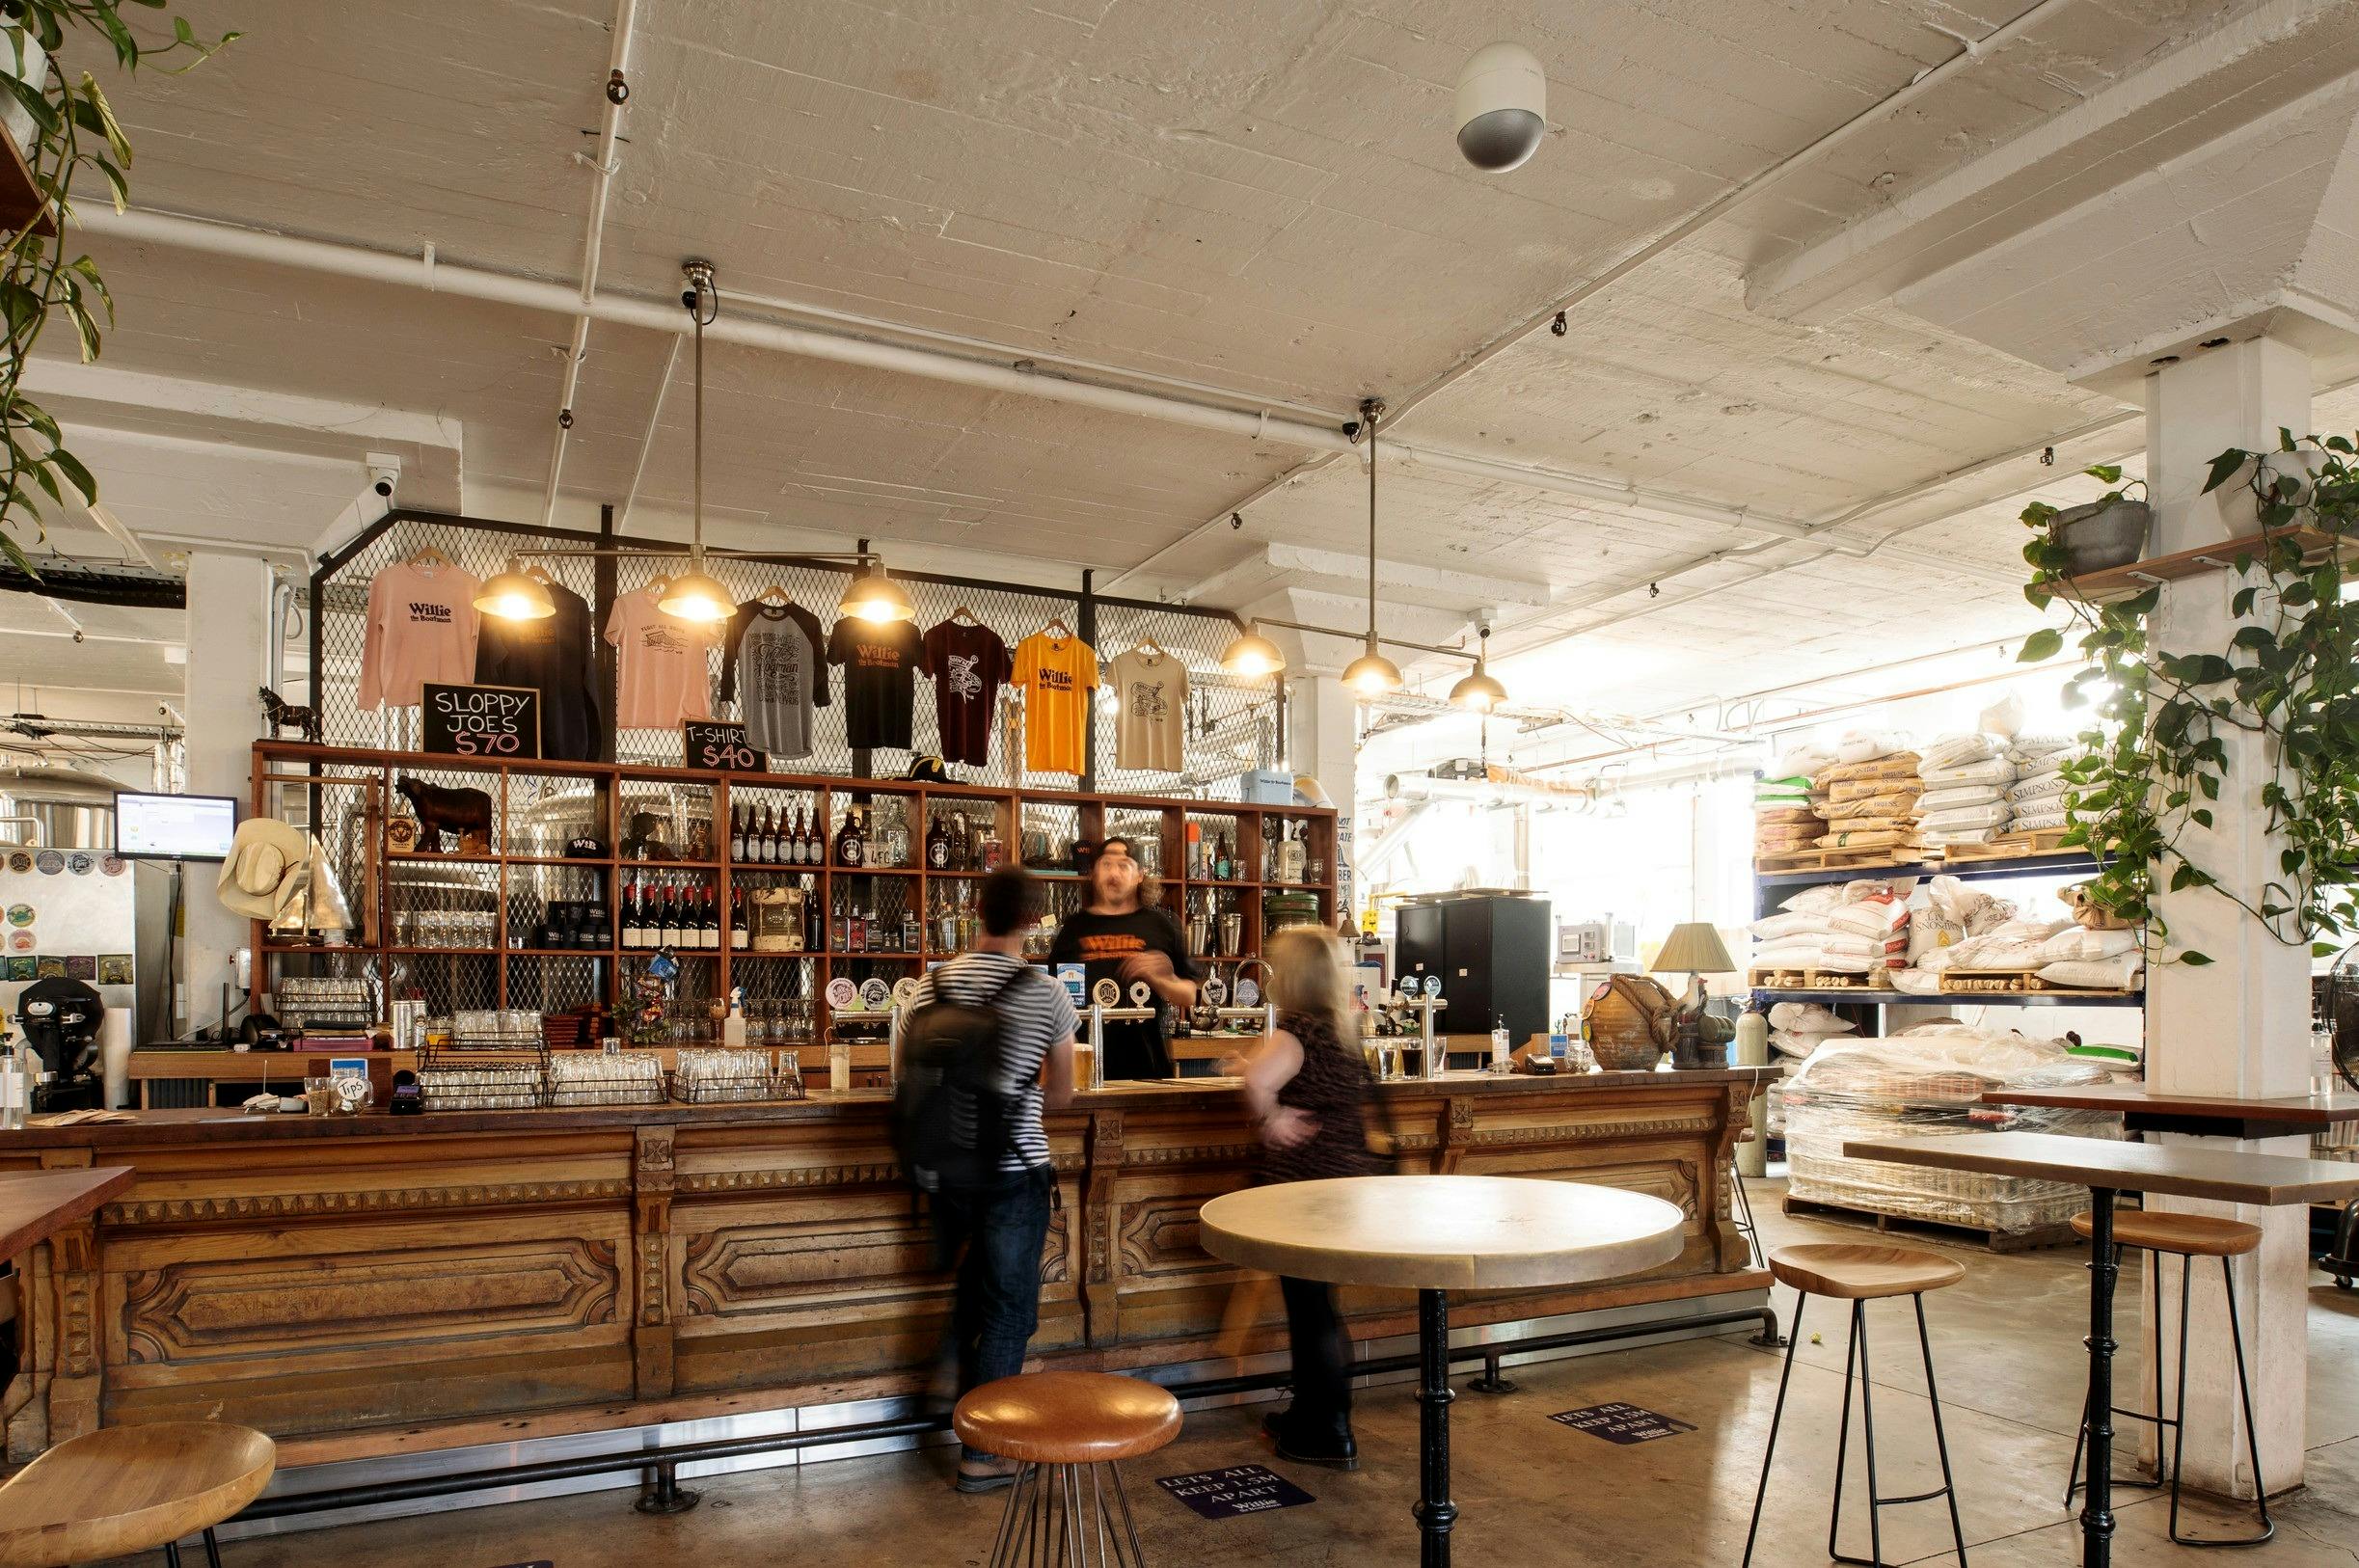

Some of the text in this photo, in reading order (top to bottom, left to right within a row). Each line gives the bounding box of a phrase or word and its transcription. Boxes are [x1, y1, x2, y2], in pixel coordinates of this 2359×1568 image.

[409, 603, 451, 616] Willie
[856, 644, 901, 660] Willie
[1039, 668, 1072, 684] Willie
[435, 692, 530, 716] SLOPPY
[447, 715, 518, 733] JOES
[455, 731, 520, 755] $70
[687, 726, 747, 744] T-SHIRT
[702, 744, 755, 769] $40
[2014, 779, 2066, 802] SIMPSONS
[2021, 800, 2061, 816] SIMPSO
[2021, 817, 2067, 831] SIMPSON
[339, 1081, 363, 1098] Tips
[1553, 1404, 1631, 1422] LETS ALL
[1572, 1417, 1613, 1429] KEEP
[1607, 1418, 1661, 1434] APART
[1161, 1467, 1262, 1487] LETS ALL
[1174, 1474, 1281, 1496] KEEP 1.5M
[1210, 1485, 1279, 1503] APART
[1232, 1499, 1278, 1510] Willie
